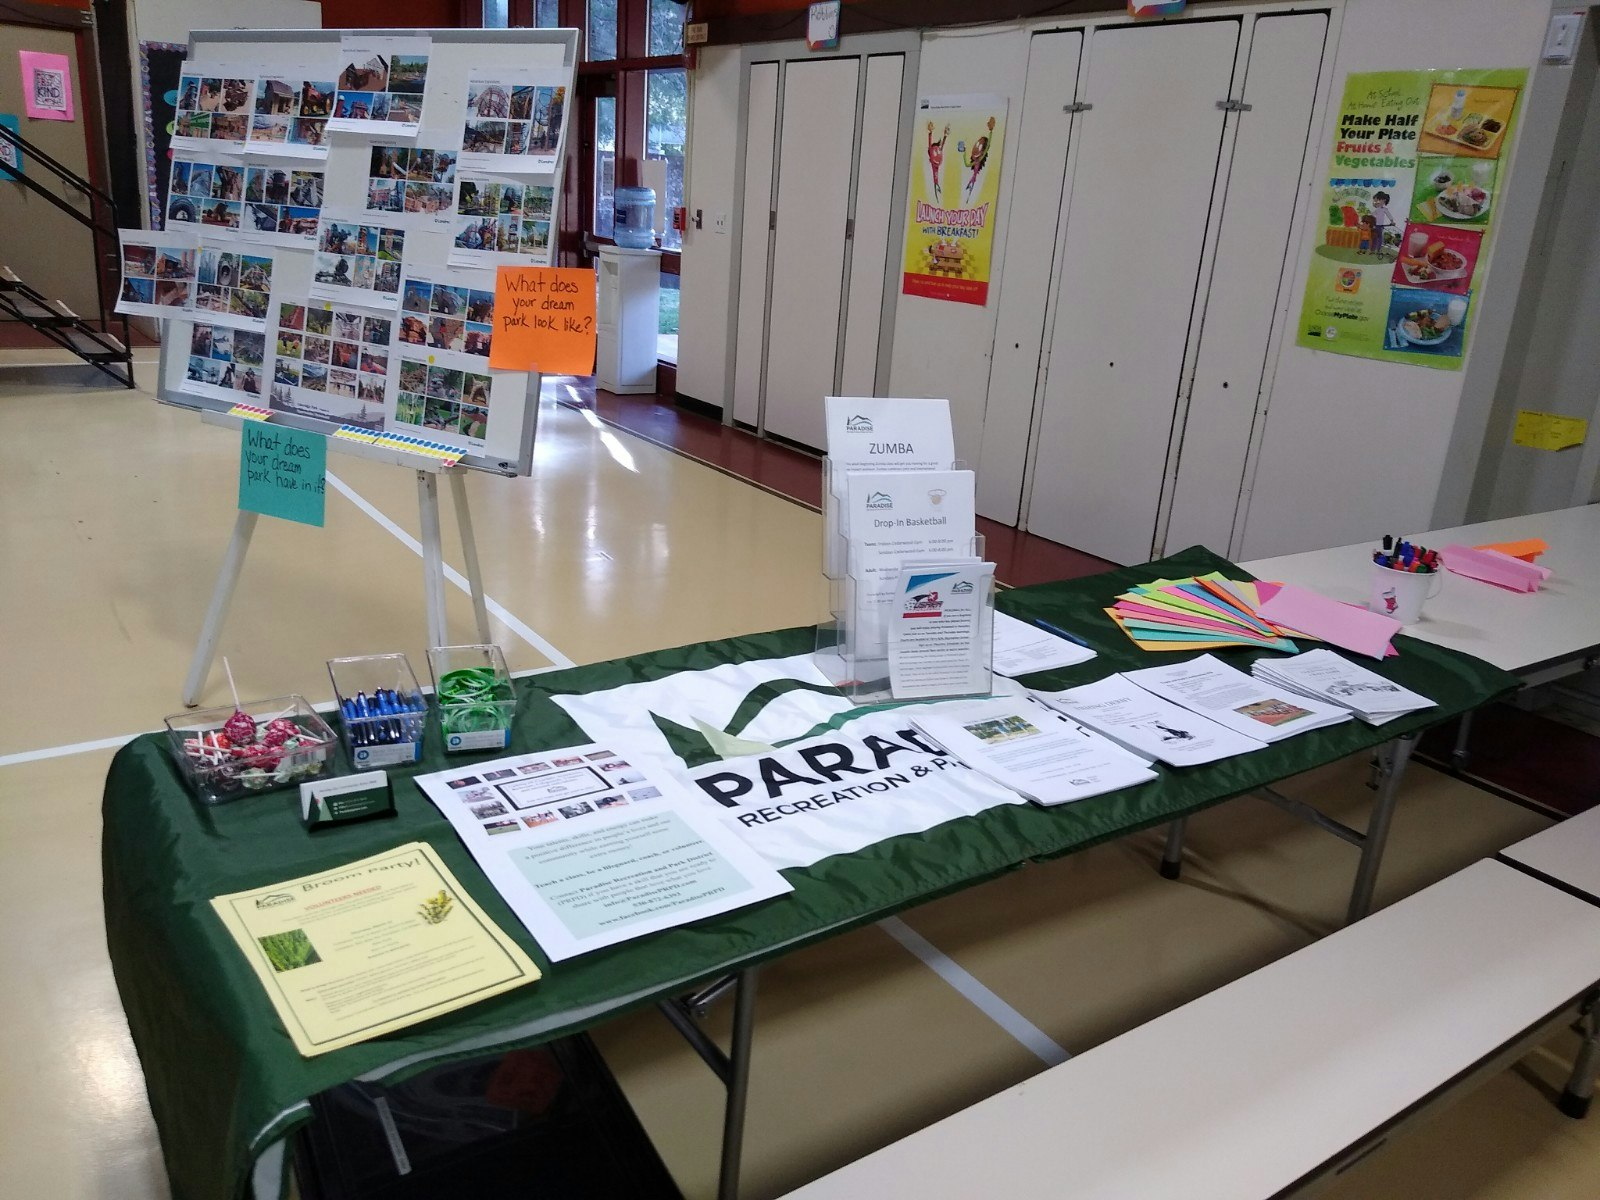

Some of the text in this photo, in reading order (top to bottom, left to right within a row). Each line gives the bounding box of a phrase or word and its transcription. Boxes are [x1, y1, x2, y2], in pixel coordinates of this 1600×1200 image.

[1341, 114, 1419, 126] Make Half
[1340, 128, 1416, 141] Your Plate
[1336, 141, 1393, 154] Fruits &
[1336, 155, 1416, 169] Vegetables
[916, 200, 989, 228] LAUNCH YOUR DAY
[937, 226, 980, 239] BREAKFAST!
[504, 271, 579, 294] What does
[512, 294, 575, 316] your dream
[502, 313, 593, 336] park look like?
[247, 428, 311, 460] What does
[869, 442, 914, 455] ZUMBA
[271, 453, 302, 475] dream
[247, 469, 272, 486] park
[275, 471, 299, 490] have
[301, 479, 312, 492] in
[873, 516, 947, 529] Drop-In Basketball
[737, 773, 911, 827] RECREATION
[910, 765, 933, 778] &
[302, 858, 421, 892] Broom Party!
[304, 885, 382, 911] VOLUNTEERS NEEDED
